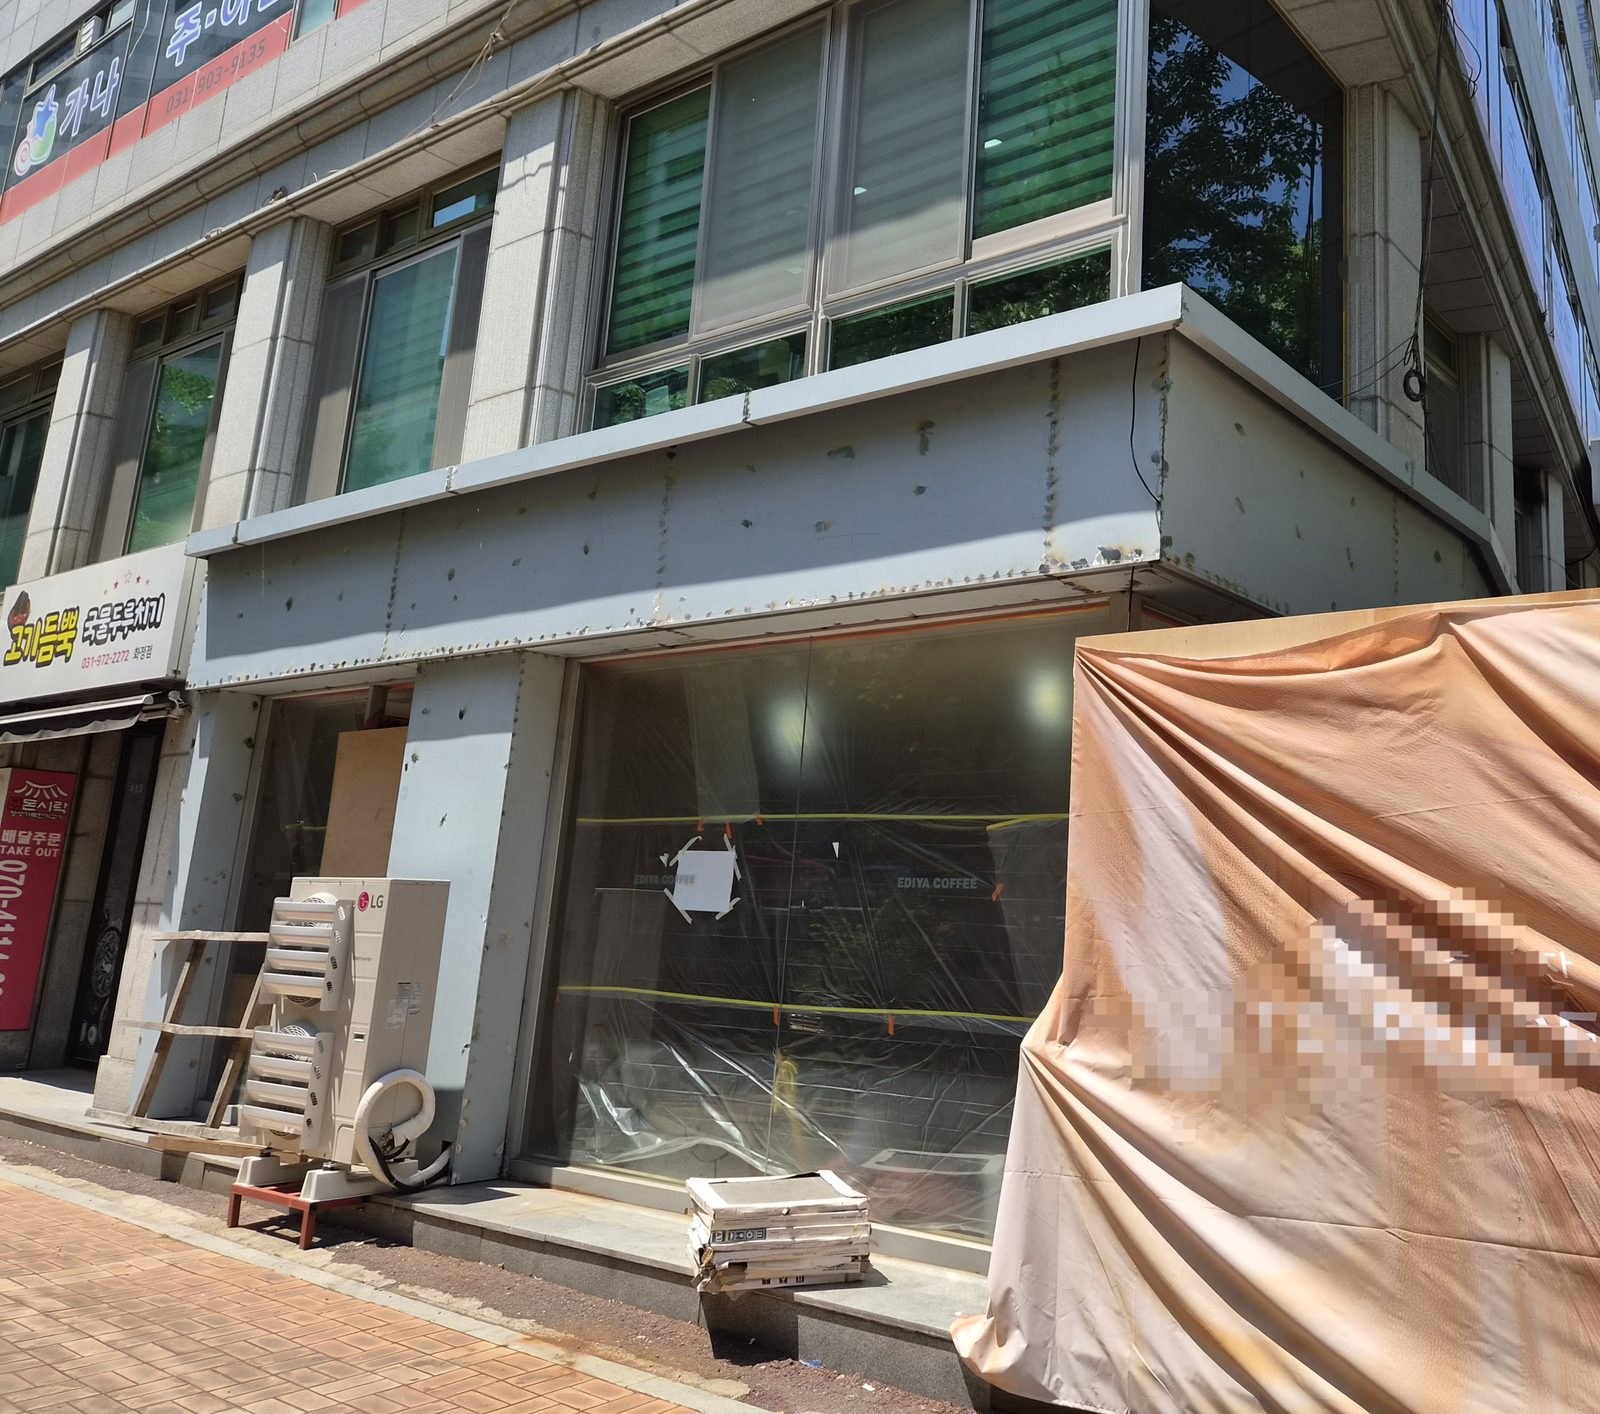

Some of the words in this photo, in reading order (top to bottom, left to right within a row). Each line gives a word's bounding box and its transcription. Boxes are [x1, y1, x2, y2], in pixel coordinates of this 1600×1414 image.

[59, 56, 120, 137] 가나
[4, 607, 80, 667] 고기듬뿍
[82, 592, 166, 646] 국물두루치기
[81, 649, 130, 669] 031-972-2272
[1, 829, 62, 847] 배달주문
[0, 844, 31, 856] TAKE
[36, 847, 60, 858] OUT
[897, 877, 930, 889] EDIYA
[933, 877, 977, 889] COFFEE
[370, 894, 384, 909] LG
